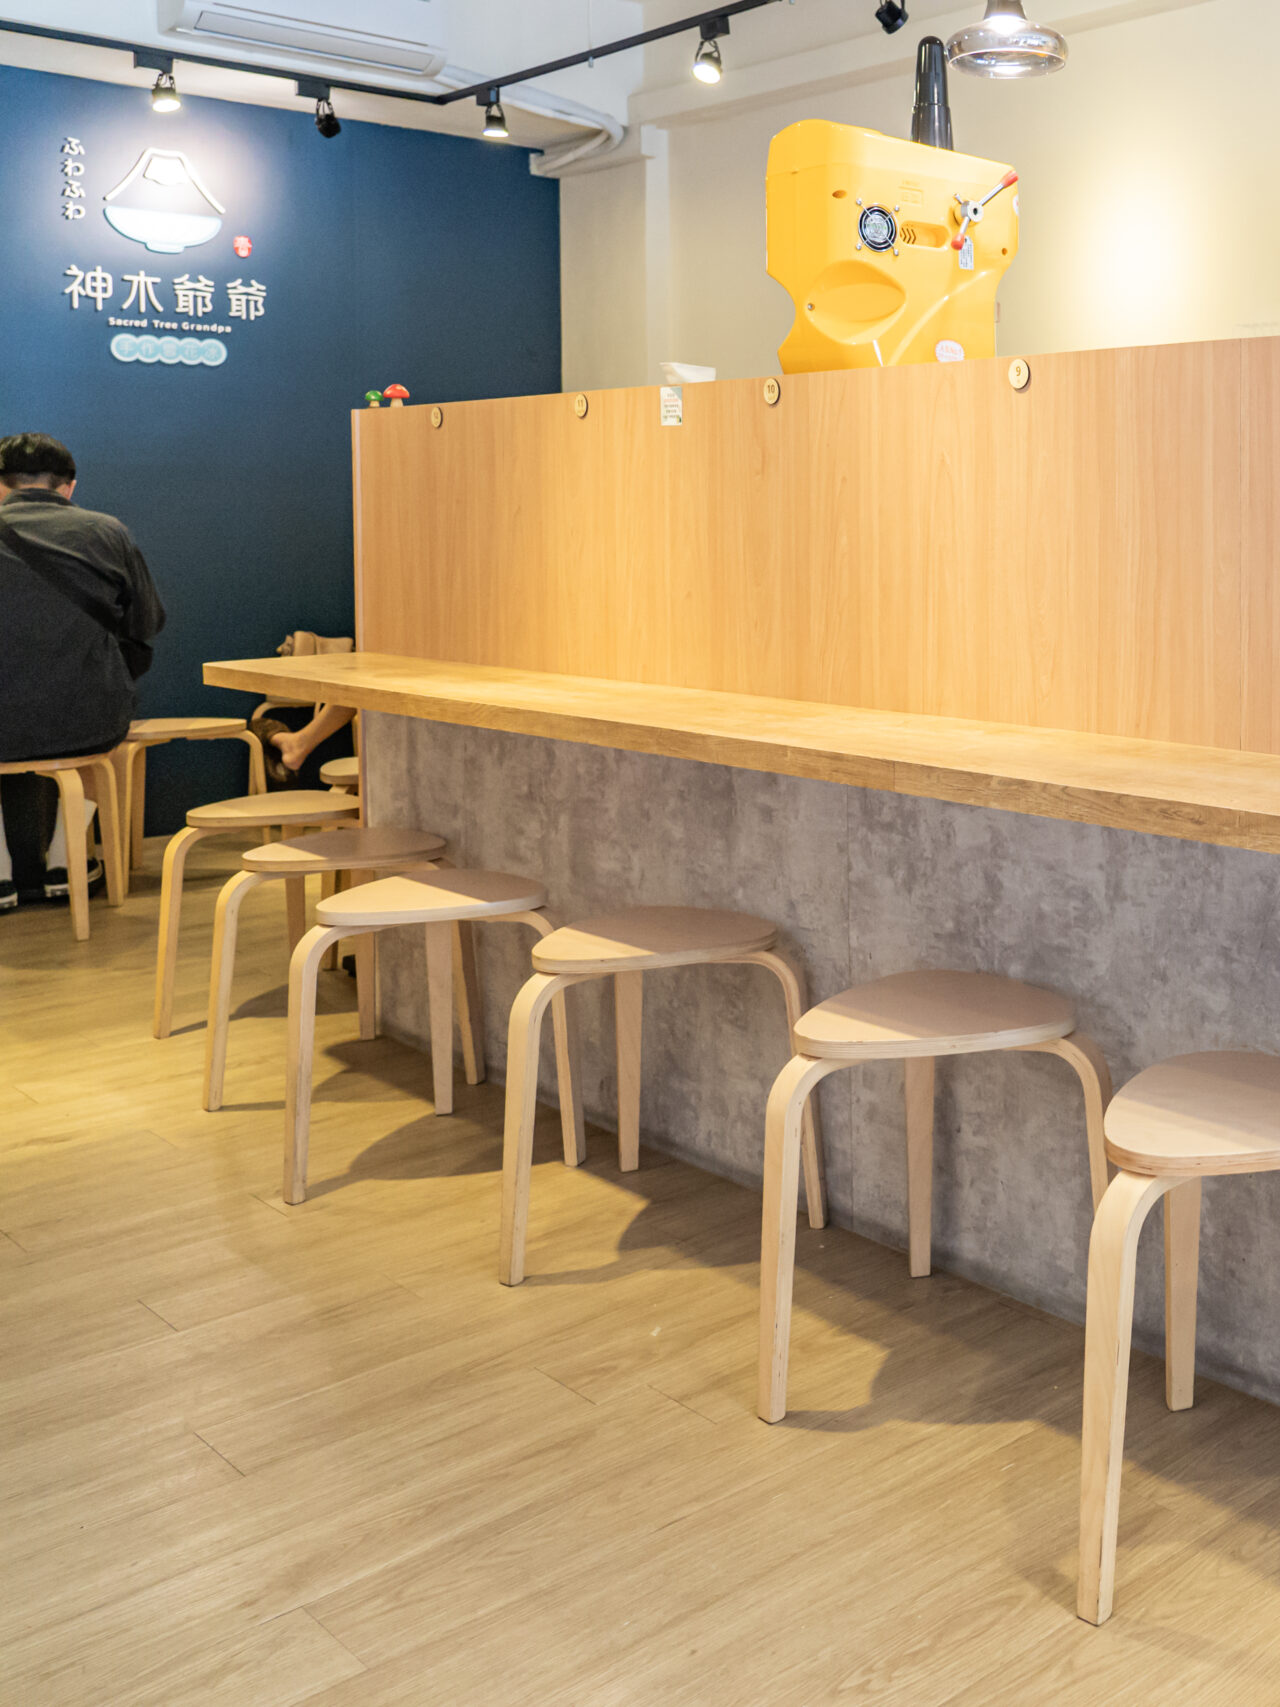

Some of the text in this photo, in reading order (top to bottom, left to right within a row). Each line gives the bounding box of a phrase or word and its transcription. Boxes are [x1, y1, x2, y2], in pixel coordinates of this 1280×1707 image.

[61, 136, 86, 220] ふわふわ
[63, 264, 268, 321] 神木爺爺
[108, 316, 232, 334] Sacred Tree Grandpa
